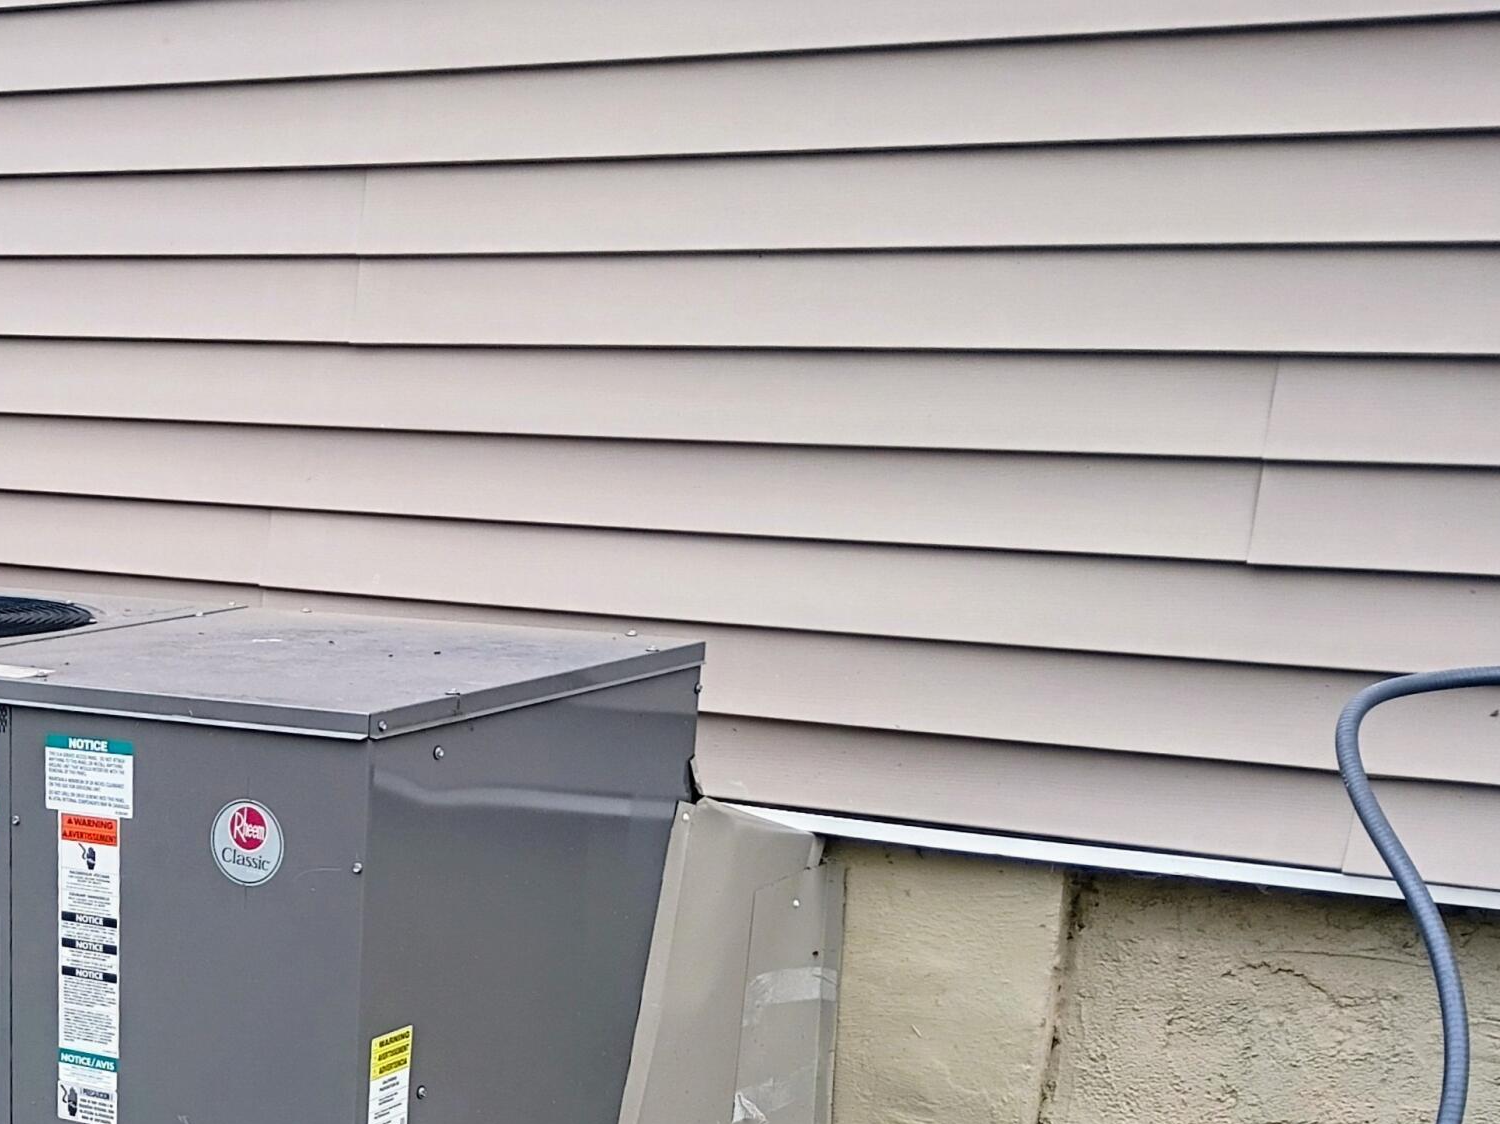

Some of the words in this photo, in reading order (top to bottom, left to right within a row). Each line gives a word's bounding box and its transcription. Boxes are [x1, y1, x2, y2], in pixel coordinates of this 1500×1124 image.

[68, 737, 108, 752] NOTICE
[73, 818, 113, 829] WARNING
[233, 807, 265, 843] Rheem
[221, 847, 270, 871] Classic
[75, 914, 104, 926] NOTICE
[75, 940, 104, 952] NOTICE
[75, 968, 104, 981] NOTICE
